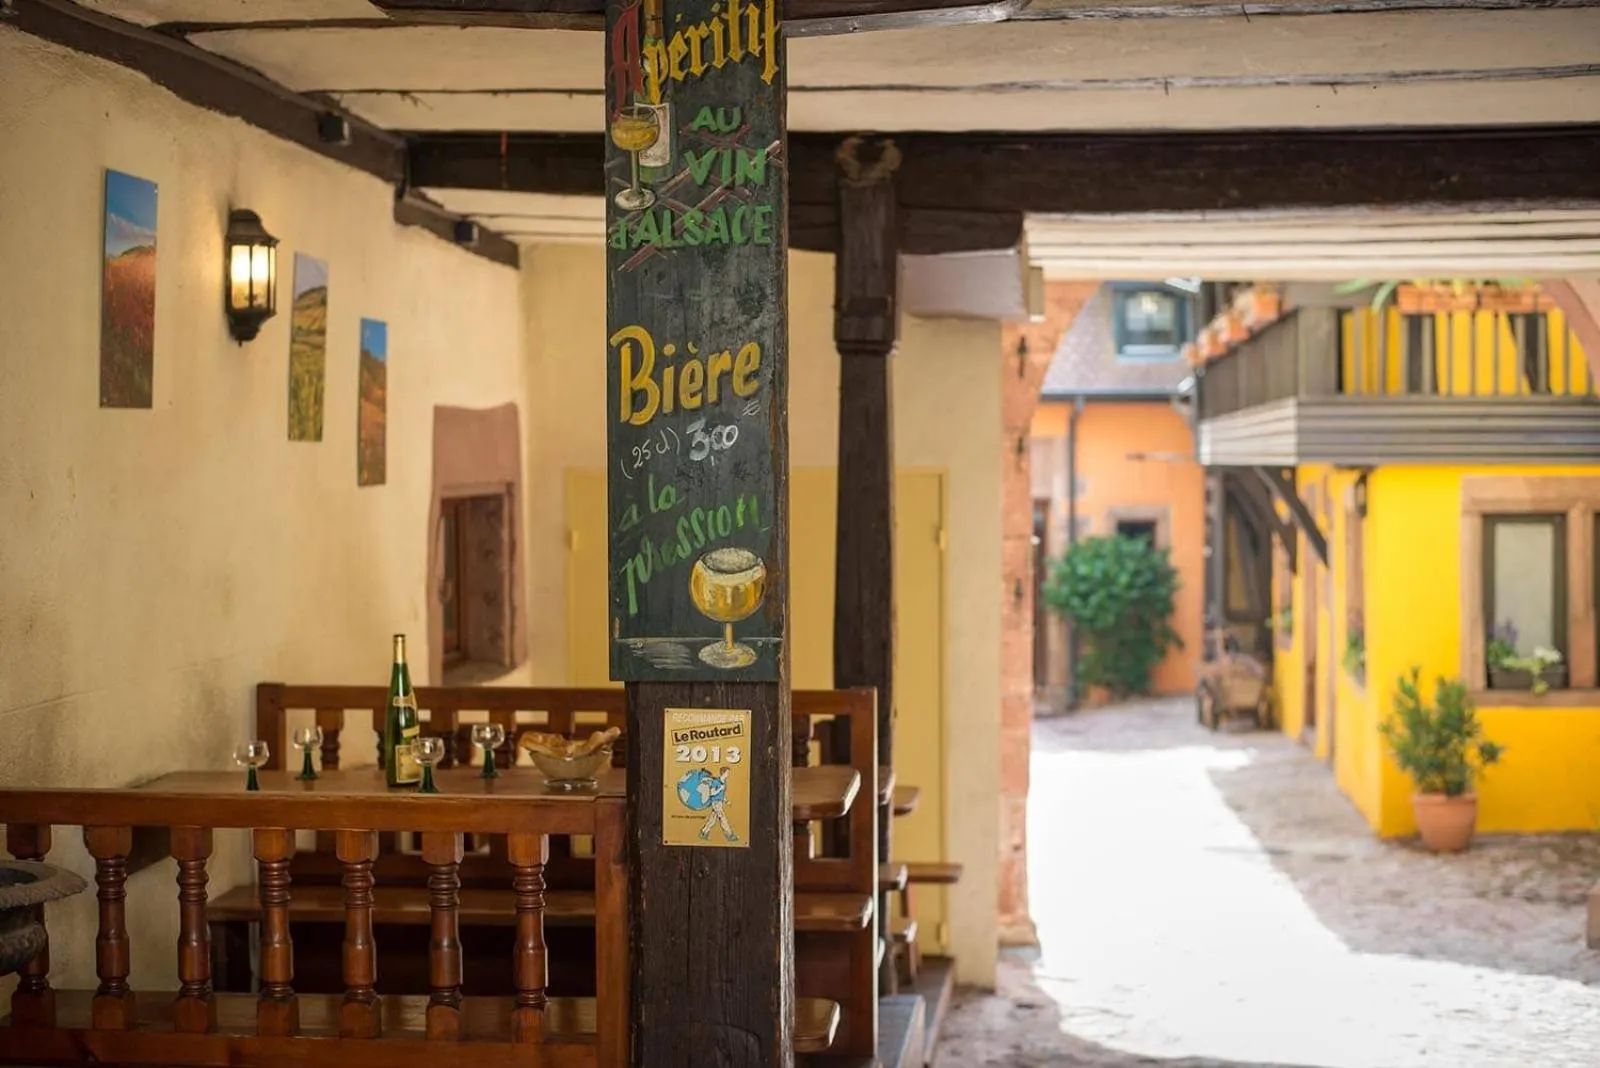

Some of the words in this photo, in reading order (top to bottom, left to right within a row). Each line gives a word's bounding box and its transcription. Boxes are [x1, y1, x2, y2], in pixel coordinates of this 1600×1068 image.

[691, 105, 742, 132] AU
[684, 147, 768, 186] VIN
[609, 324, 763, 426] Bière
[648, 473, 679, 514] la
[618, 491, 764, 616] pression
[675, 744, 741, 764] 2013
